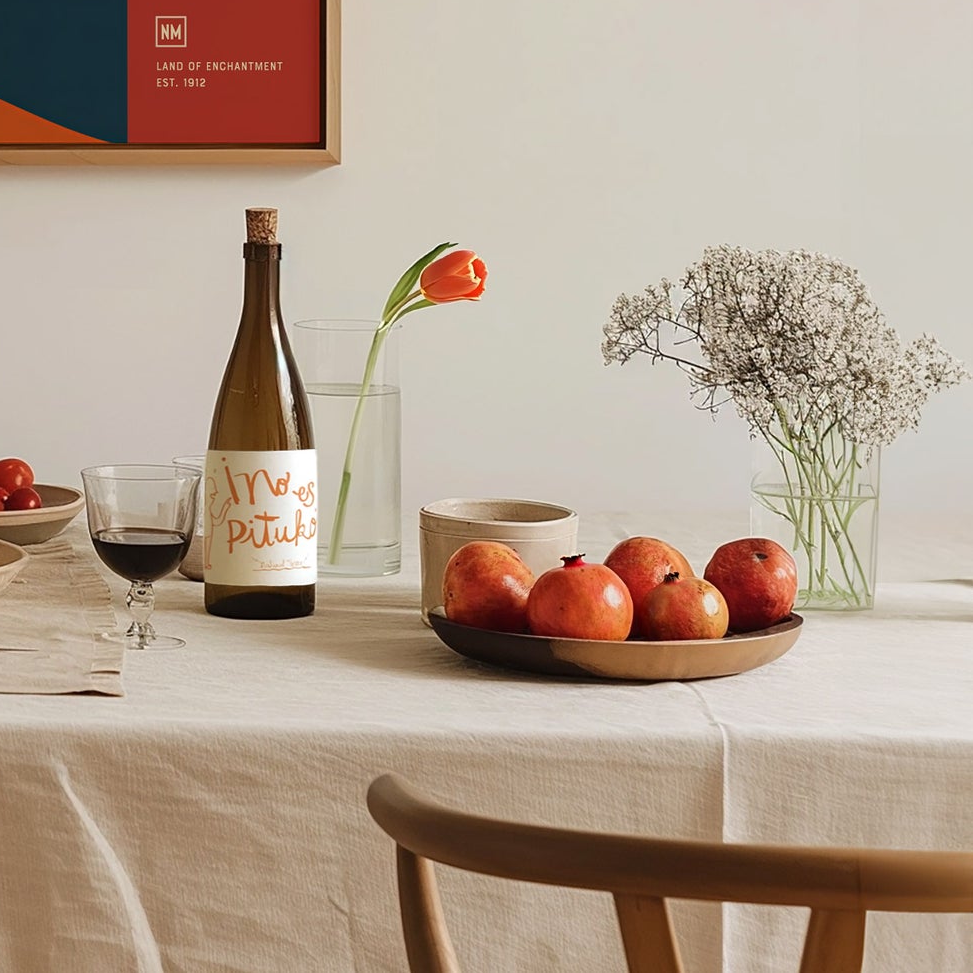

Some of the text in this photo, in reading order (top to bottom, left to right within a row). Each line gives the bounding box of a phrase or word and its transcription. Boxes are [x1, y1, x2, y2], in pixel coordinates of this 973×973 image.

[160, 23, 182, 40] NM
[156, 61, 284, 71] LAND OF ENCHANTMENT
[156, 78, 206, 88] EST. 1912
[292, 481, 315, 508] es
